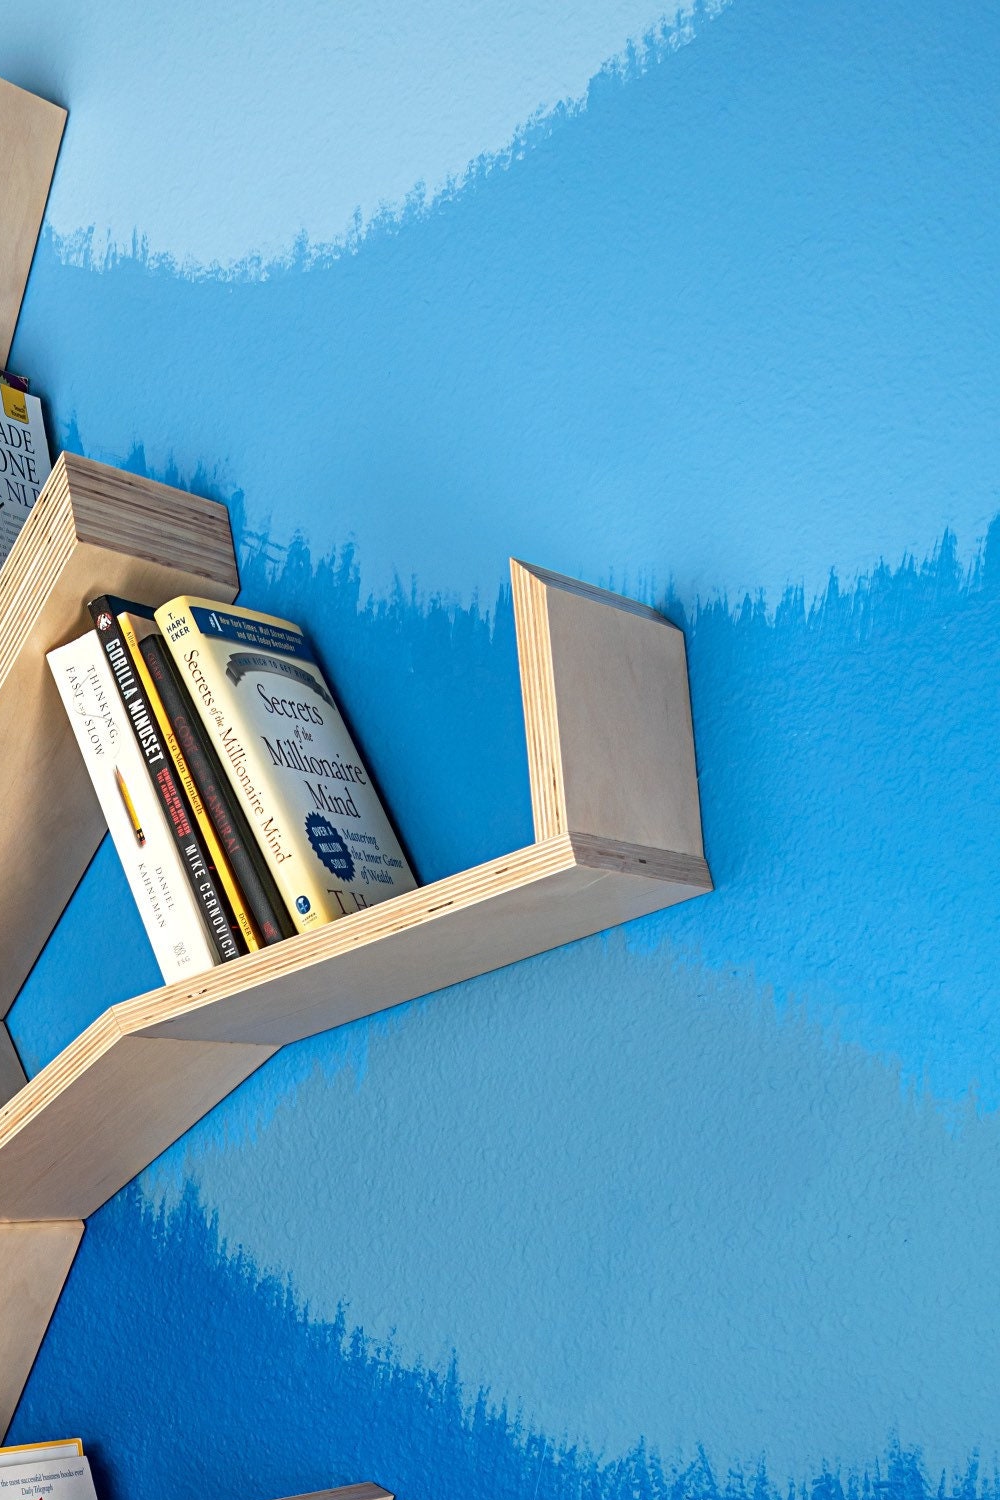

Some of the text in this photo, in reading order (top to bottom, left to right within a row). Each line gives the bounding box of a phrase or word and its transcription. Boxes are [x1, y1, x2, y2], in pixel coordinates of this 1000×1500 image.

[166, 616, 186, 633] HARV
[170, 626, 191, 643] EKER
[66, 665, 105, 757] FAST AND SLOW
[86, 664, 120, 745] THINKING,
[105, 638, 131, 700] GORILLA
[128, 700, 163, 765] MINDSET
[256, 683, 324, 727] Secrets
[260, 735, 367, 786] Millionaire
[304, 780, 362, 820] Mind
[138, 863, 167, 928] KAHNEMAN
[155, 867, 175, 912] DANIEL
[184, 844, 236, 959] MIKE CERNOVICH
[238, 913, 252, 937] DOVER
